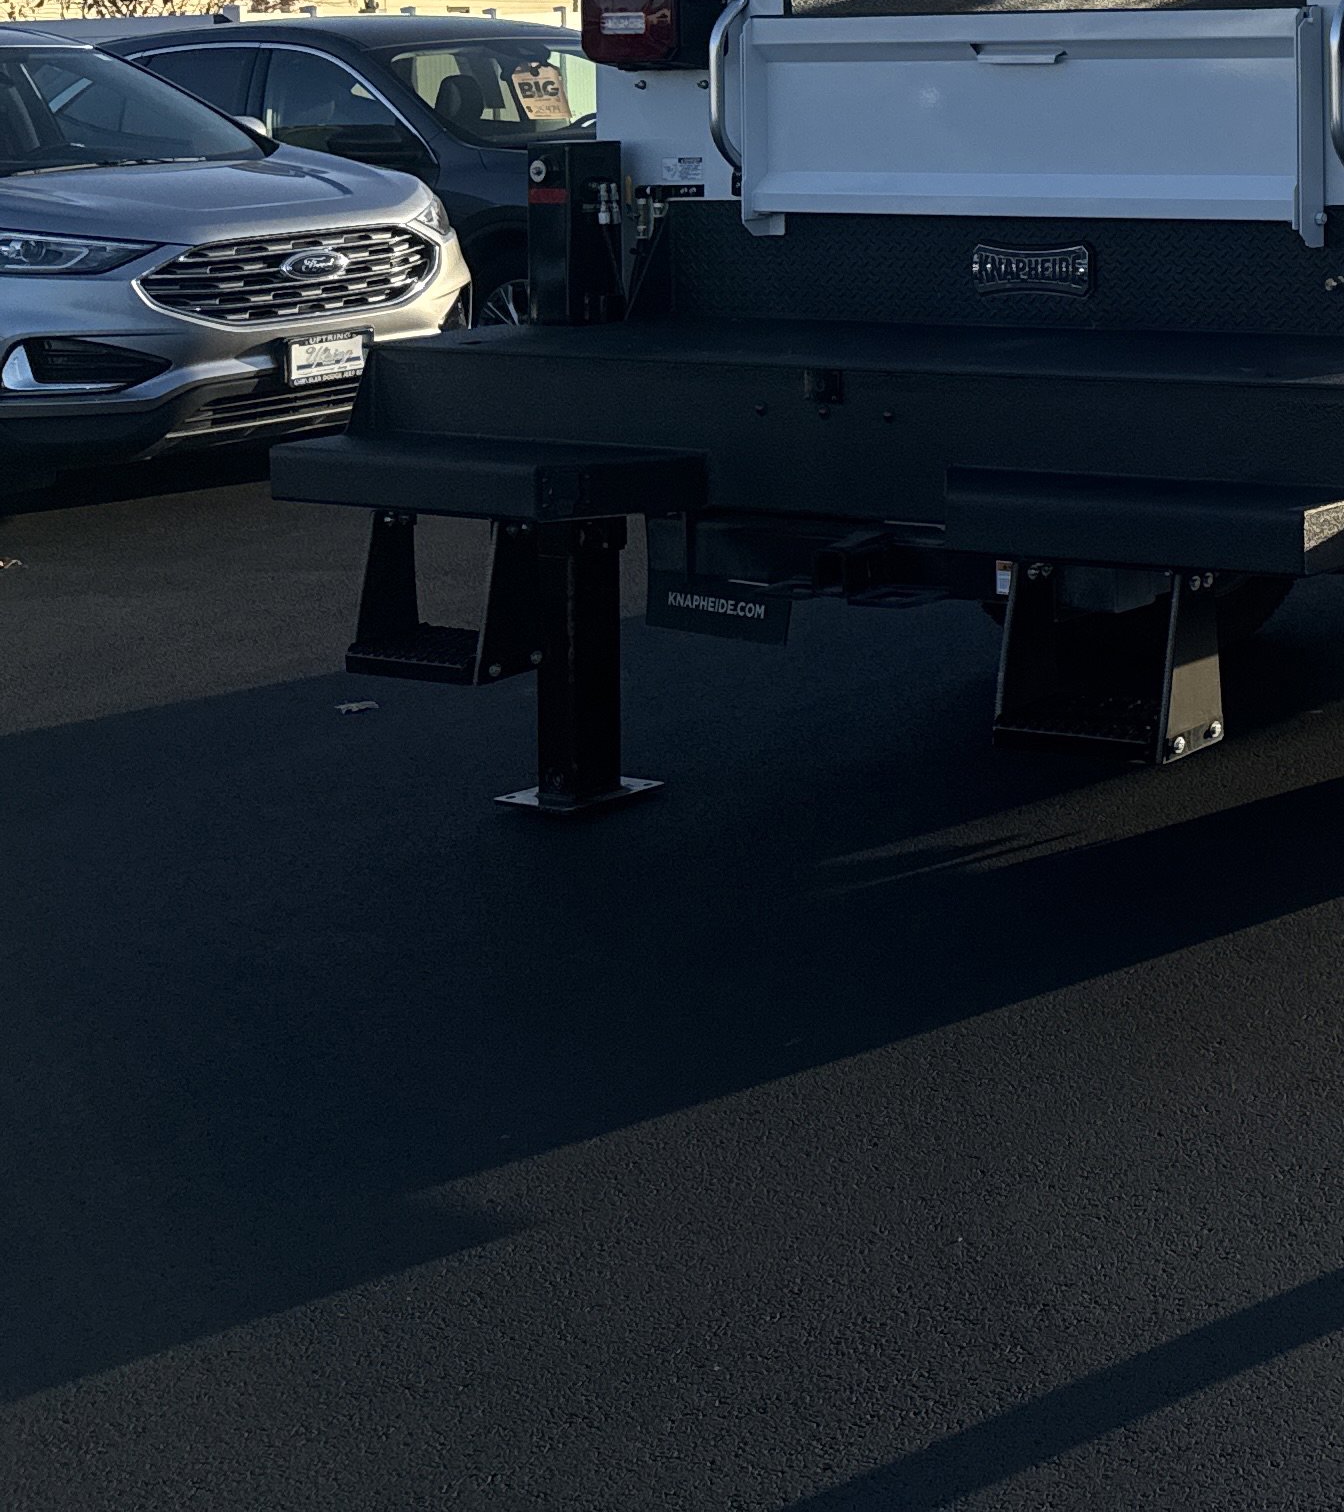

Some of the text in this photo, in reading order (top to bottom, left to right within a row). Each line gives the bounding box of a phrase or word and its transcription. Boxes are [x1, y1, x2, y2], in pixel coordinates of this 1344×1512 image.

[517, 80, 560, 99] BIG
[976, 251, 1087, 289] KNAPHEIDE
[667, 591, 766, 620] KNAPHEIDE.COM
